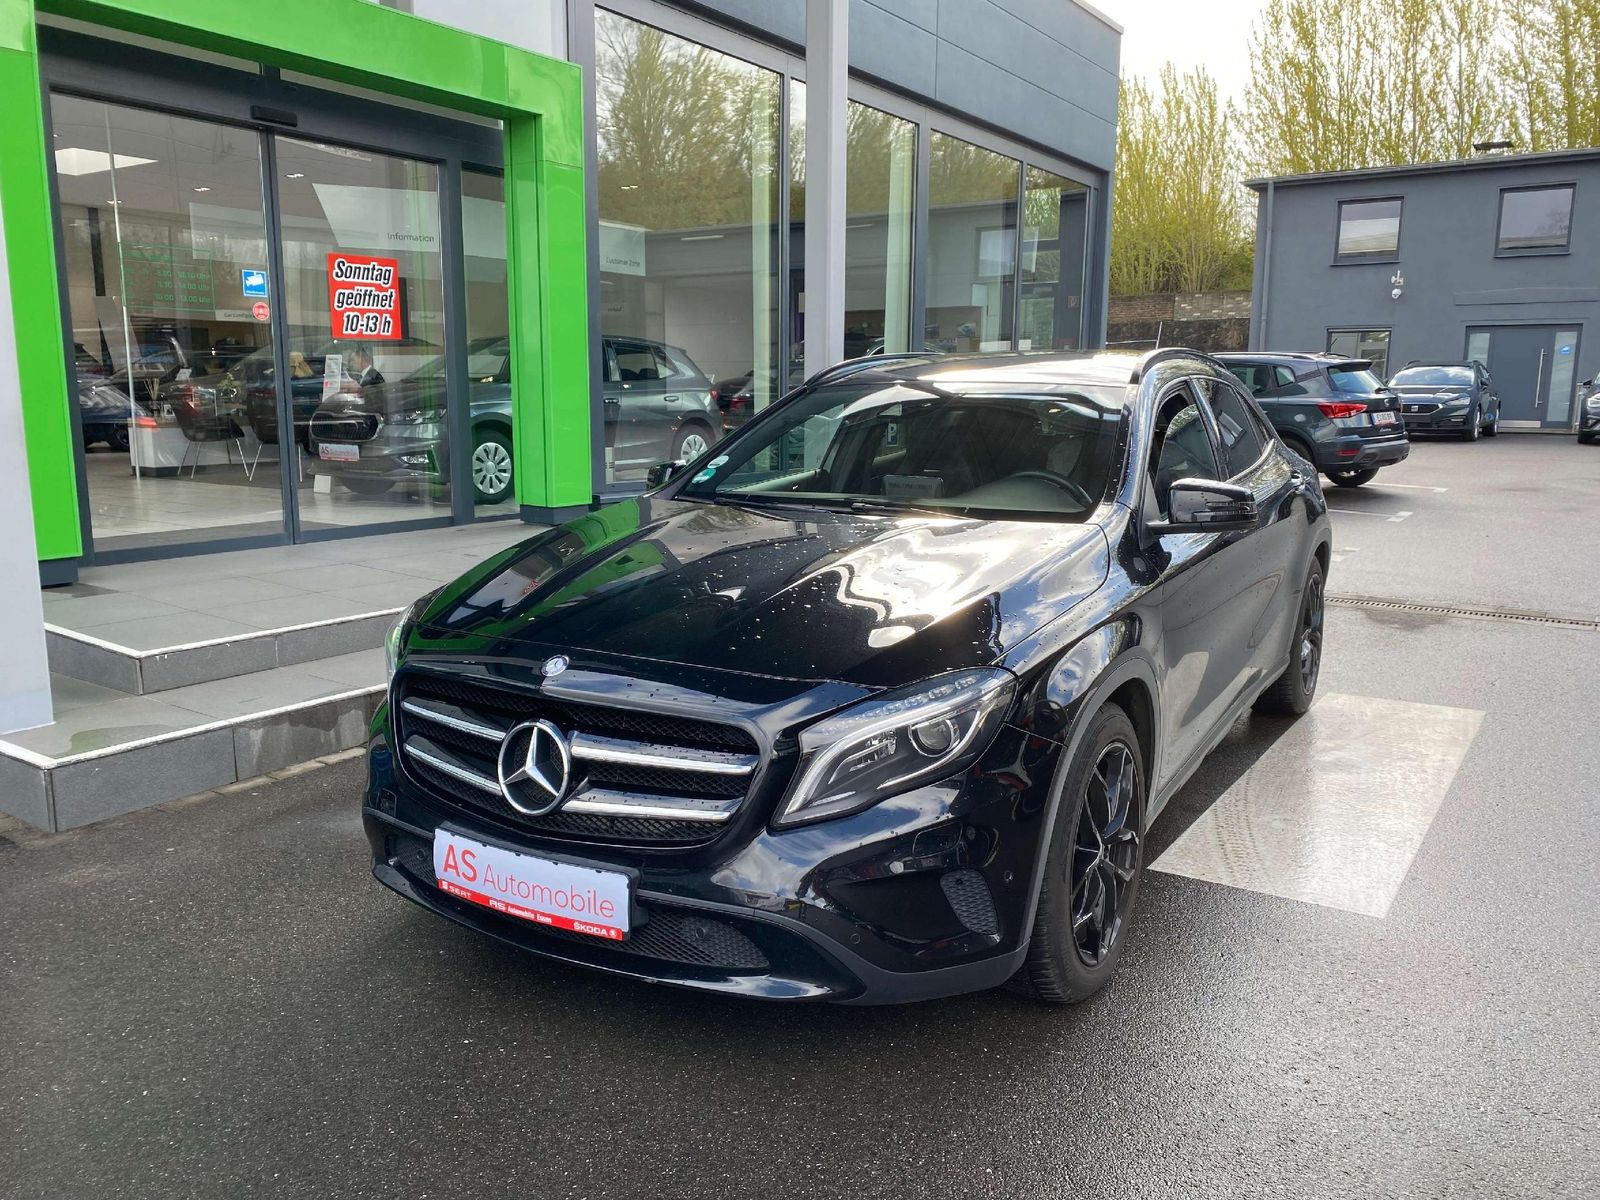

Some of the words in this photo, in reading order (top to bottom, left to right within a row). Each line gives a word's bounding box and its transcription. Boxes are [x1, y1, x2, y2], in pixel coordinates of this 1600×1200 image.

[387, 232, 435, 242] Information
[334, 260, 393, 286] Sonntag
[336, 288, 395, 309] geöffnet
[343, 313, 379, 334] 10-13
[381, 315, 392, 334] h
[887, 423, 897, 442] P
[443, 843, 478, 883] AS
[482, 864, 615, 919] Automobile
[489, 899, 506, 911] AS
[573, 921, 608, 936] ŠKODA
